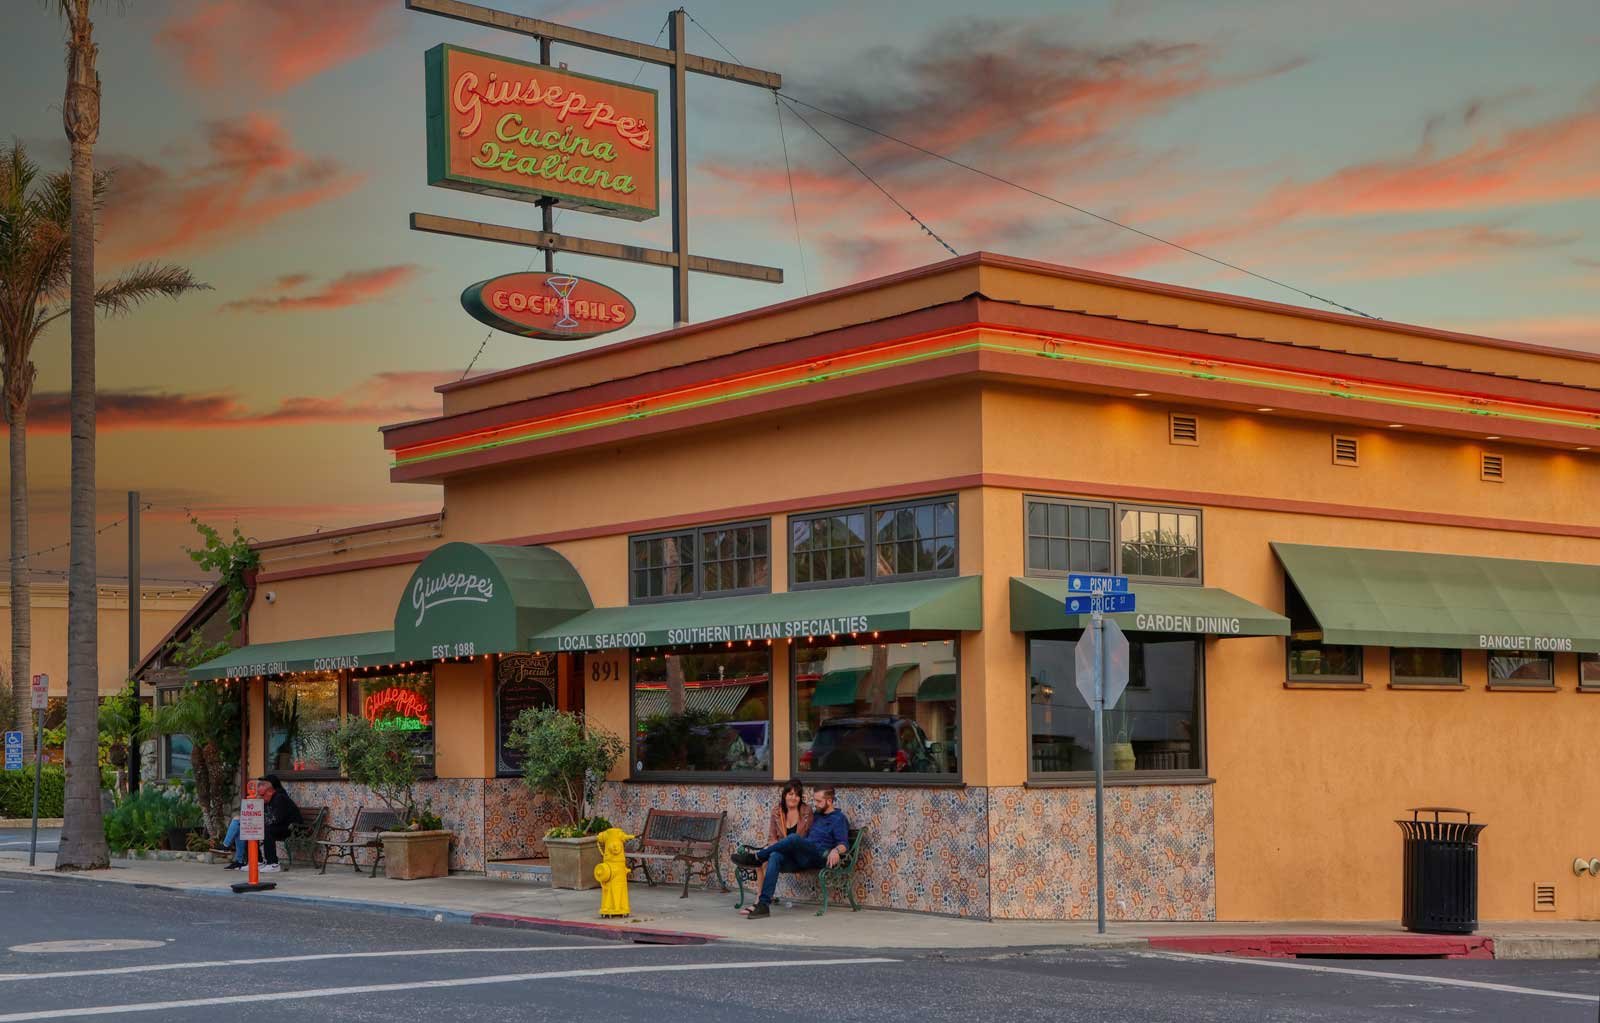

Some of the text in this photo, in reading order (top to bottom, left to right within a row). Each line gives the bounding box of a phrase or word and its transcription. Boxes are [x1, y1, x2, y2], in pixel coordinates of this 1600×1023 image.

[453, 71, 651, 151] Giuseppe's
[496, 113, 618, 162] Cucina
[472, 142, 636, 193] Italiana
[492, 291, 626, 323] COCKTAILS
[1090, 577, 1112, 592] PISMO
[413, 573, 493, 627] Giuseppe's
[1090, 596, 1116, 613] PRICE
[668, 616, 867, 645] SOUTHERN ITALIAN SPECIALTIES
[1136, 614, 1240, 633] GARDEN DINING
[432, 642, 474, 658] EST. 1988
[558, 631, 646, 650] LOCAL SEAFOOD
[1480, 635, 1572, 650] BANQUET ROOMS
[226, 661, 290, 678] WOOD FIRE GRILL
[313, 656, 360, 671] COCKTAILS
[591, 661, 620, 681] 891
